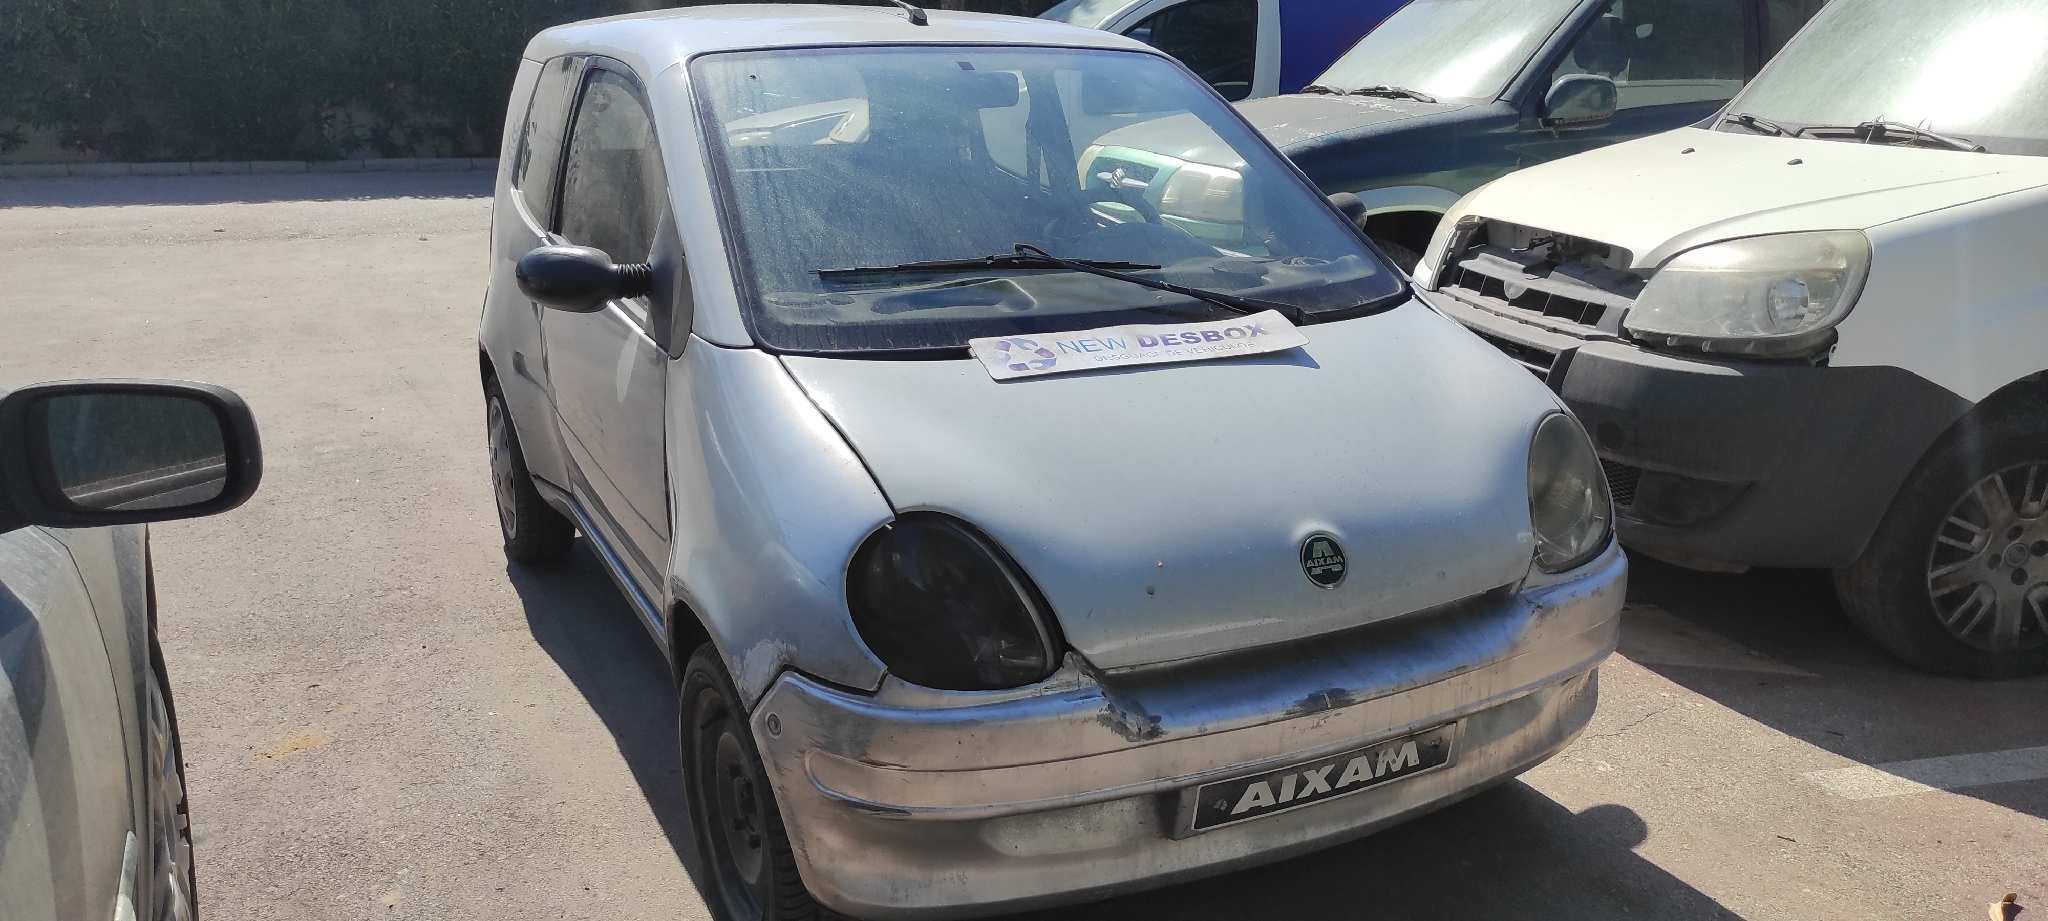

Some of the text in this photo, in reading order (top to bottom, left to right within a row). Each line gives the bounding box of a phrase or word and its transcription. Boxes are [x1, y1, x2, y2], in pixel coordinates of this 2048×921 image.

[1056, 324, 1268, 354] NEW DESBOX
[1306, 555, 1344, 568] AIXAM
[1231, 741, 1419, 815] AIXAM
